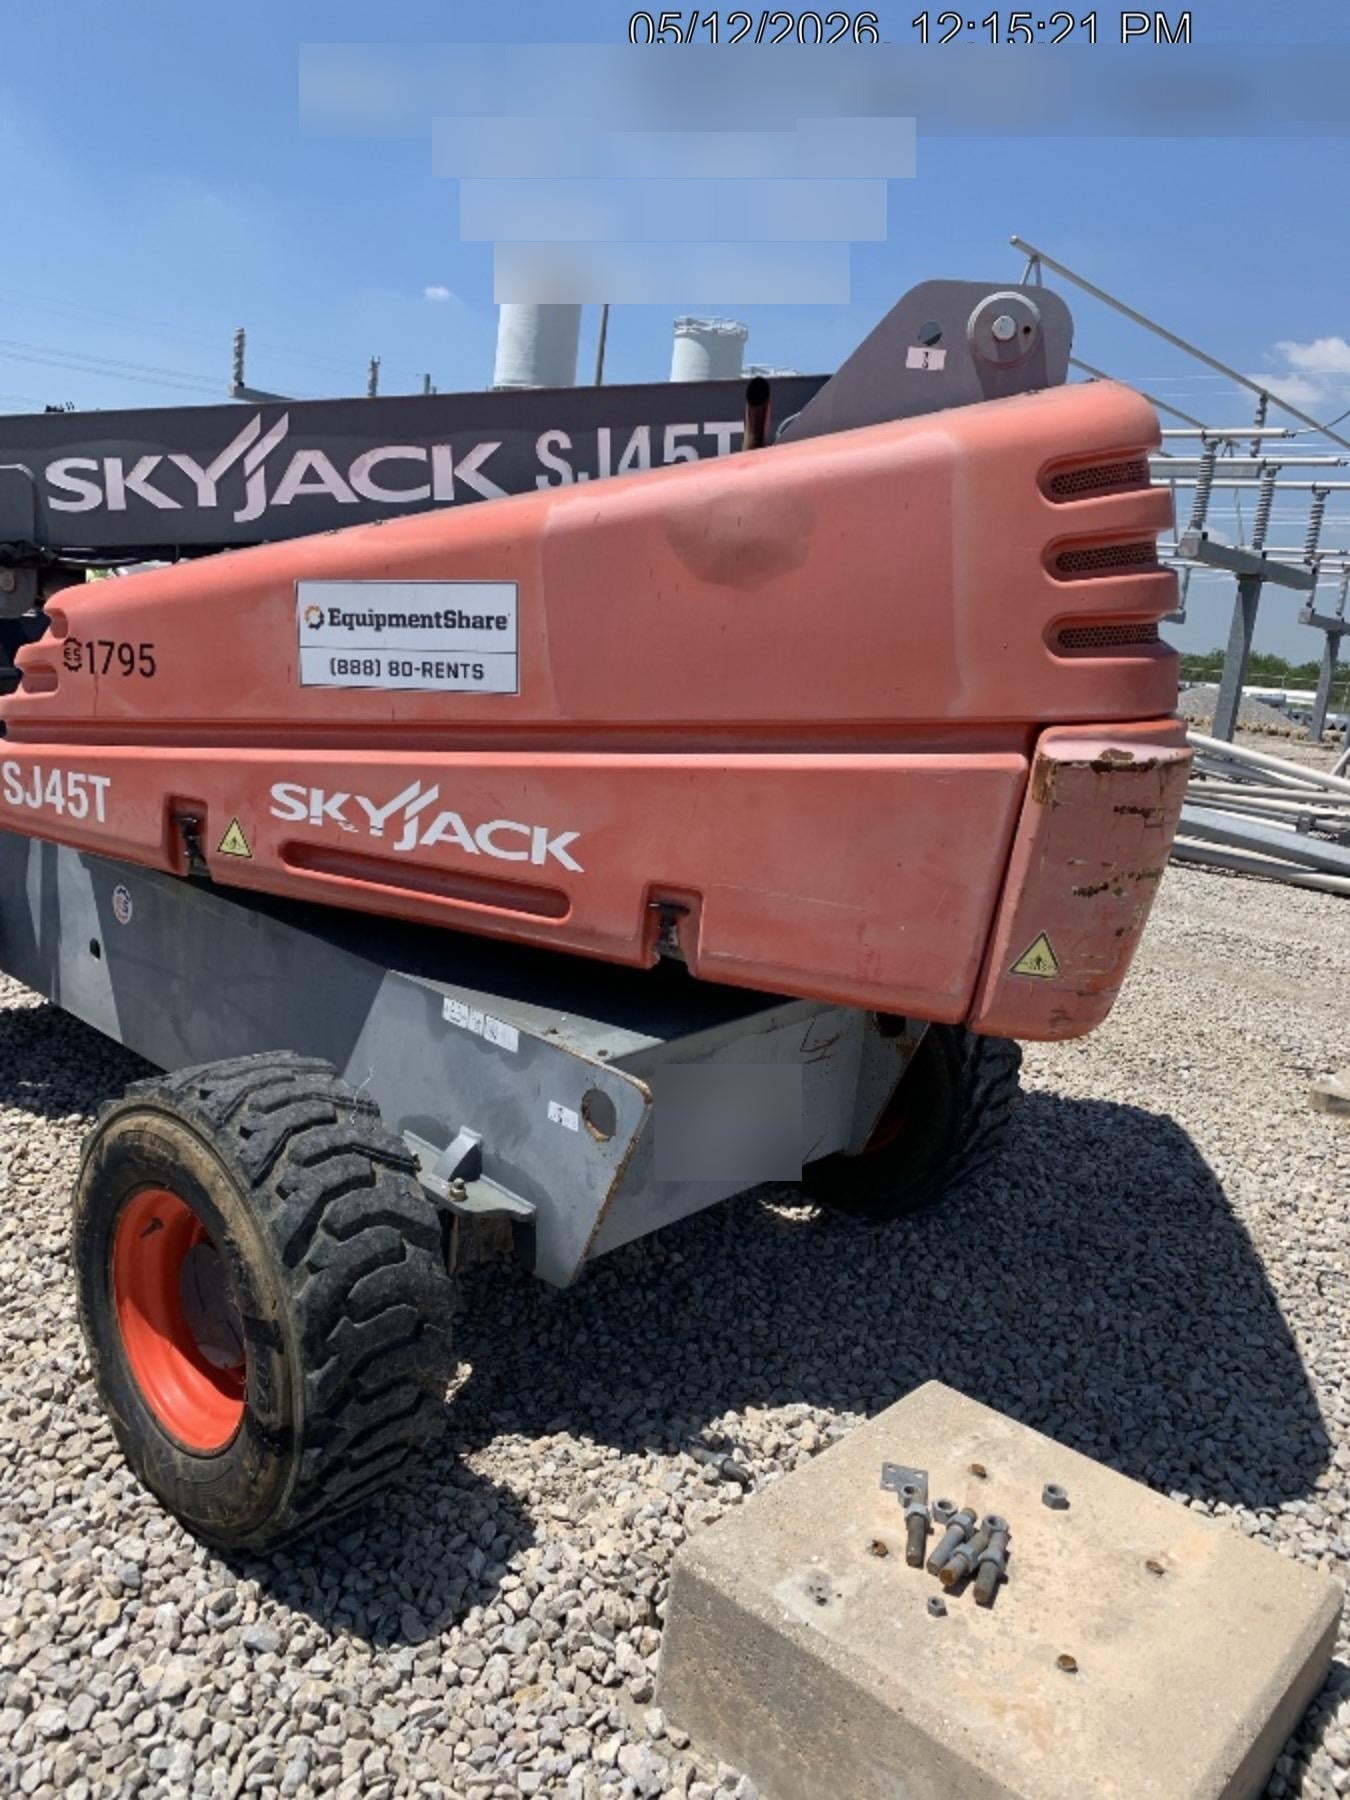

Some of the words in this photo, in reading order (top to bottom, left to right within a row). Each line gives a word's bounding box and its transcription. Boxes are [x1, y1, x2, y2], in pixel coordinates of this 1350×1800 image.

[45, 412, 511, 522] SKYJACK
[327, 607, 508, 632] EquipmentShare
[85, 640, 156, 678] 1795
[330, 657, 381, 677] (888)
[2, 761, 111, 823] SJ45T
[270, 780, 584, 873] SKYJACK
